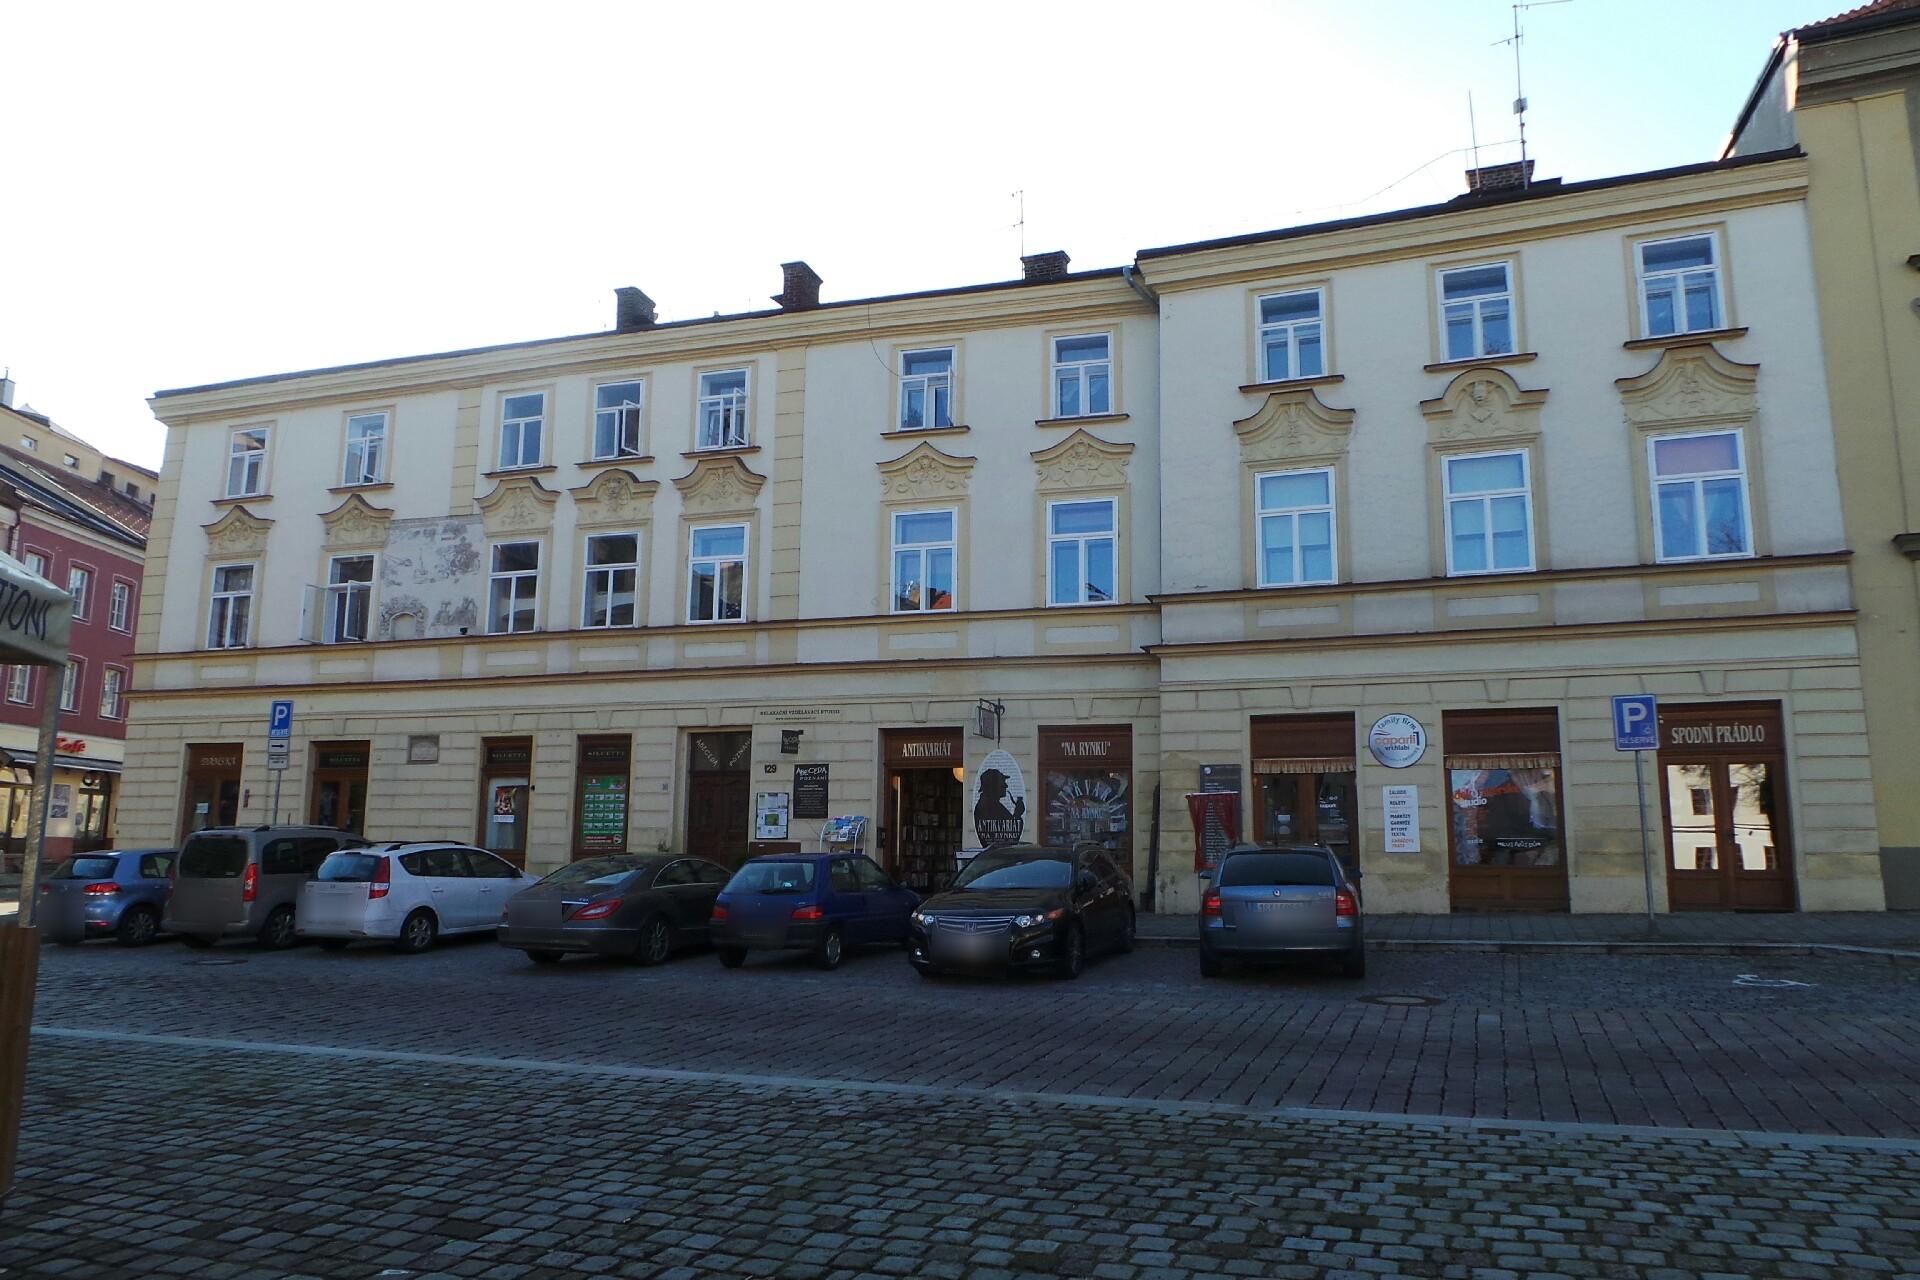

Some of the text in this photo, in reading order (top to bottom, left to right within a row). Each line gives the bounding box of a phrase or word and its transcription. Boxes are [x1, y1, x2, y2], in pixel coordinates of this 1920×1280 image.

[274, 706, 288, 726] P
[1377, 716, 1416, 730] family firm
[1622, 702, 1648, 733] P
[1671, 722, 1765, 744] SPODNÍ PRÁDLO
[902, 740, 952, 758] ANTIKVARIÁT
[764, 764, 777, 774] 129
[977, 817, 1021, 832] ANTIKVARIÁT
